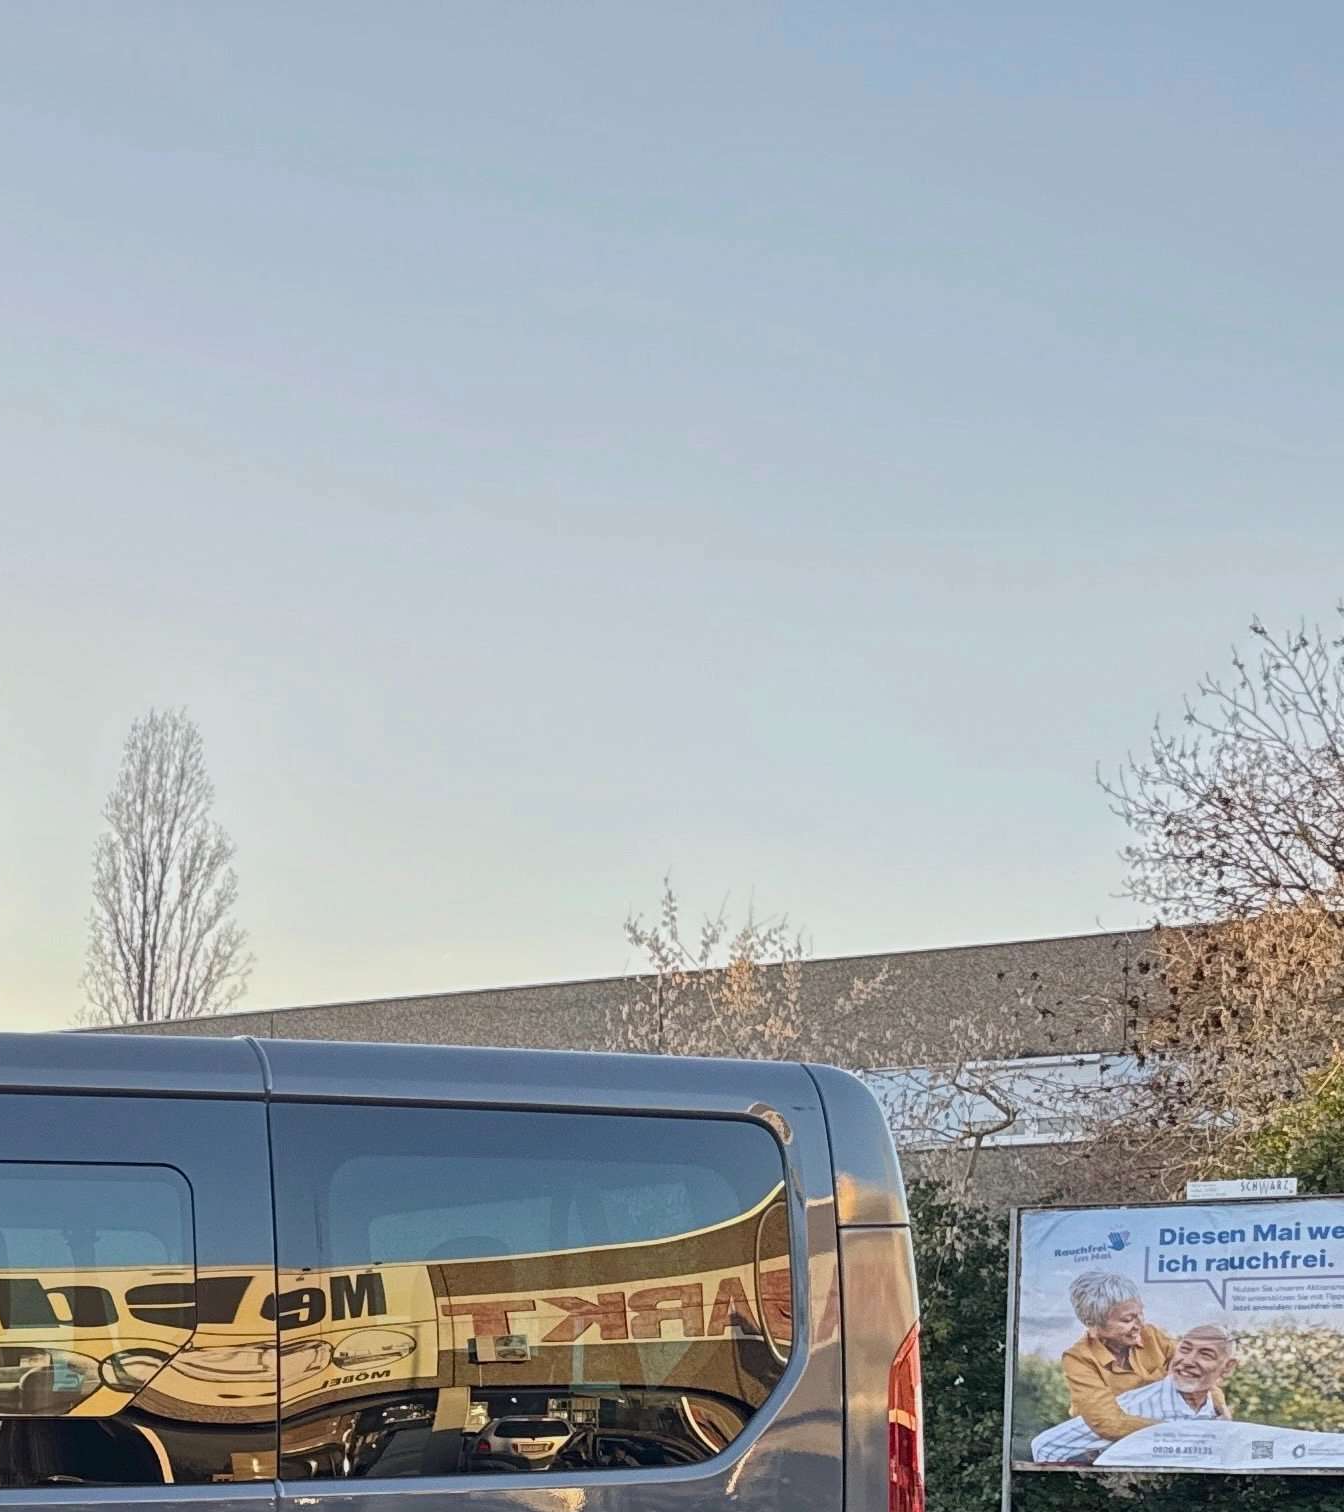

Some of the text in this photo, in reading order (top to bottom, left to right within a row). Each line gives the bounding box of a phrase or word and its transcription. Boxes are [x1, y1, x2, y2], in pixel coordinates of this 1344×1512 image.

[1240, 1180, 1289, 1195] SCHWARZ
[1159, 1226, 1246, 1246] Diesen
[1253, 1222, 1301, 1242] Mai
[1158, 1249, 1335, 1273] ich rauchfrei.
